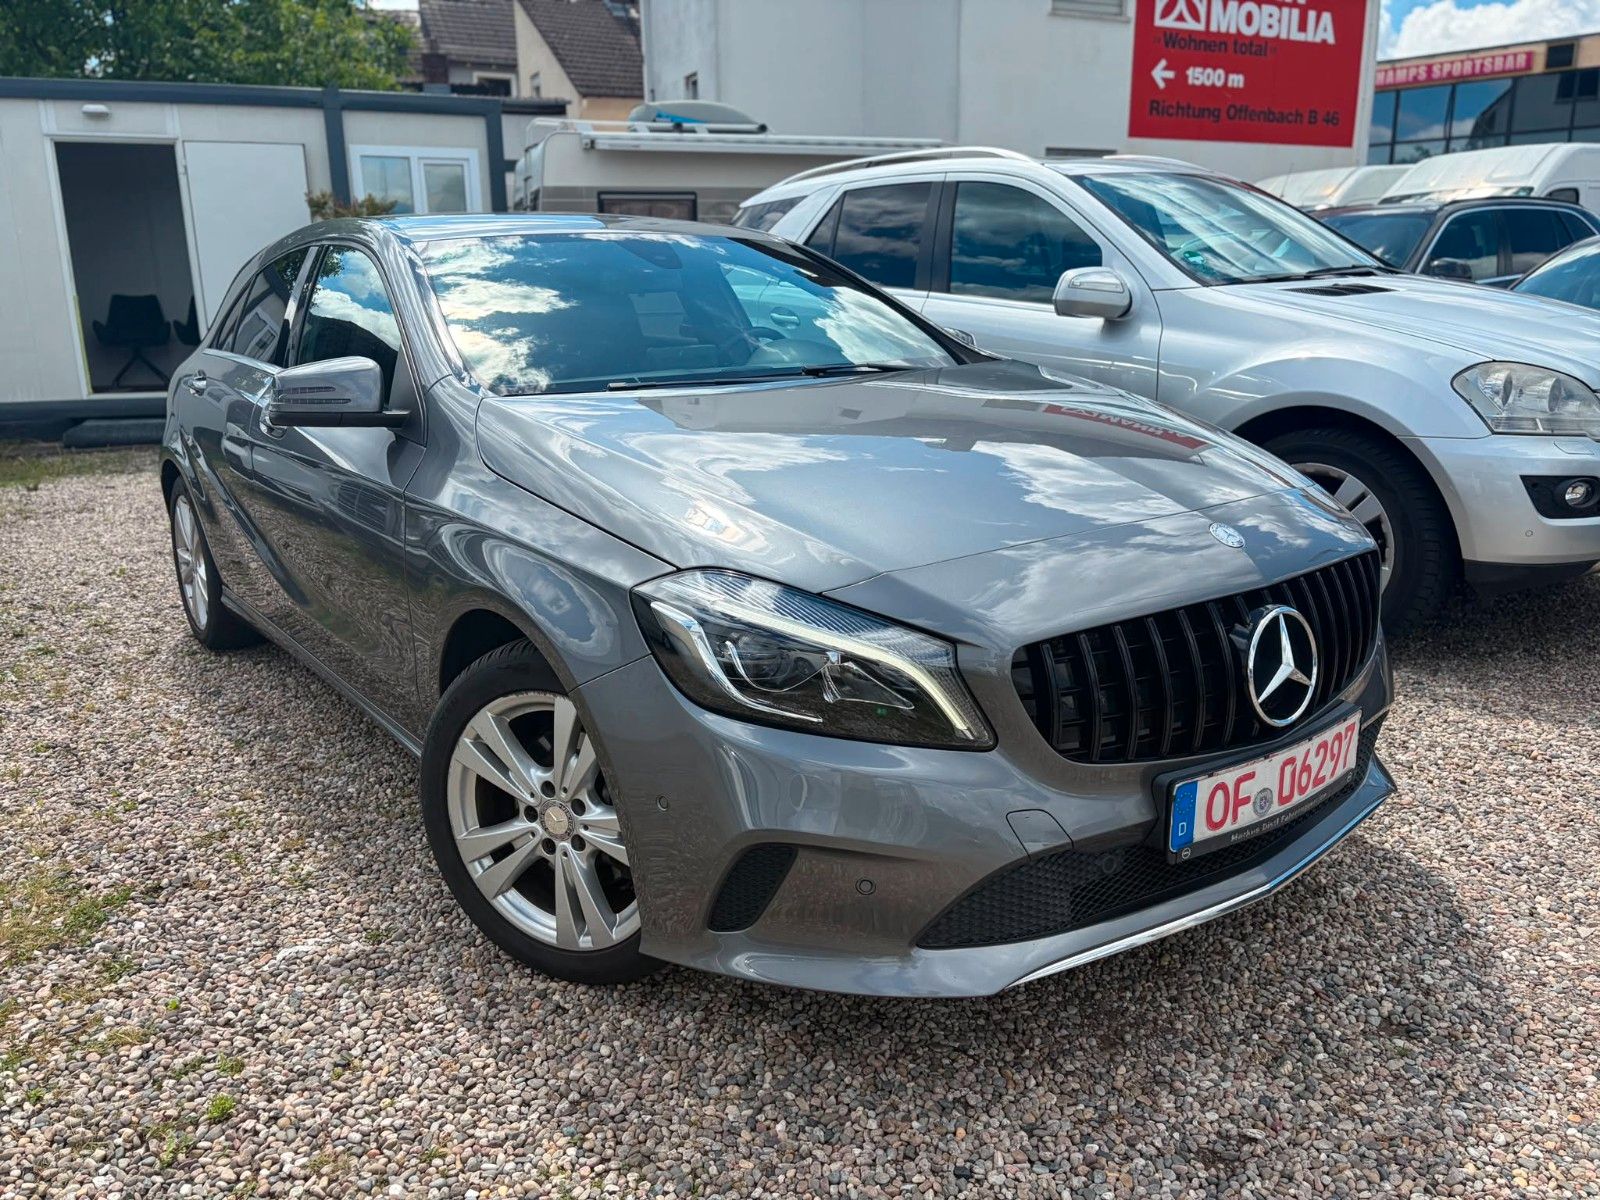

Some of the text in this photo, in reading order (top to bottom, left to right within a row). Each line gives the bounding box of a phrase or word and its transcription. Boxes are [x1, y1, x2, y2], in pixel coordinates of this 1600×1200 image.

[1209, 1, 1336, 45] MOBILIA
[1163, 32, 1268, 56] Wohnen total
[1186, 66, 1245, 88] 1500 m
[1431, 53, 1527, 79] SPORTSBAR
[1149, 100, 1339, 126] Richtung Offenbach B 46
[1205, 770, 1256, 831] OF
[1178, 821, 1187, 837] D
